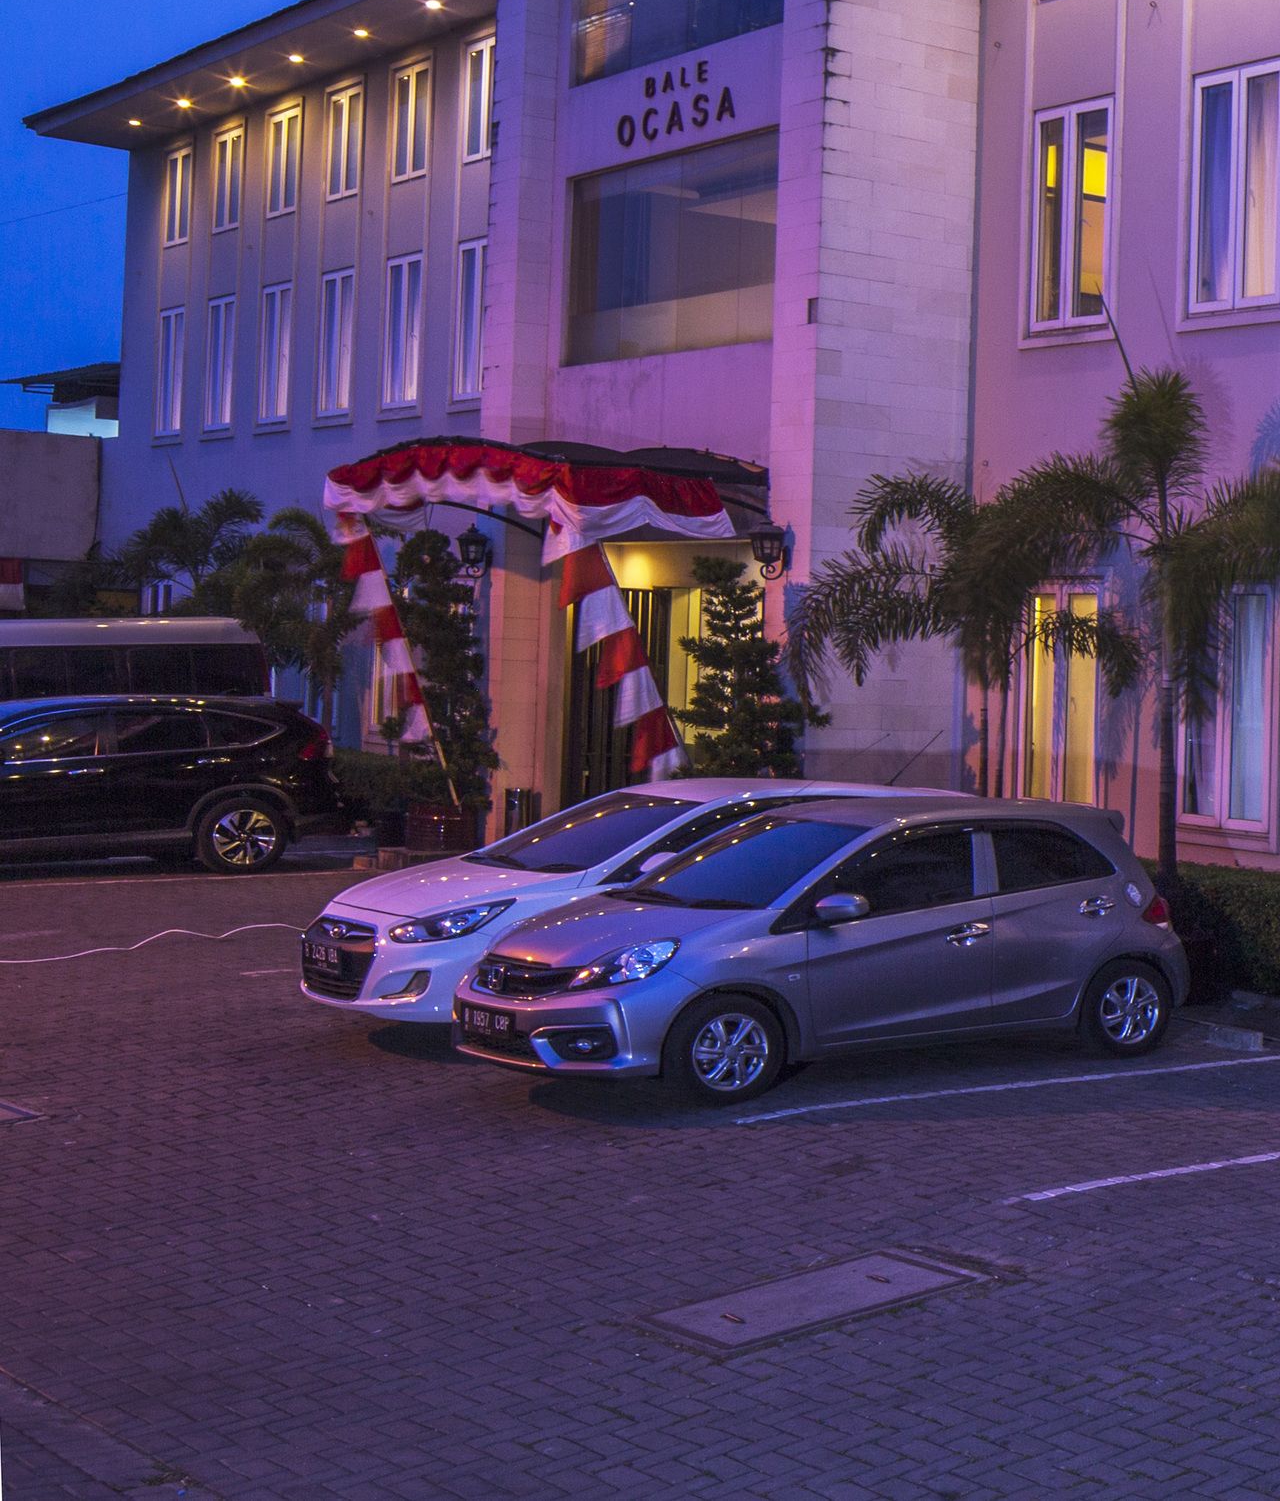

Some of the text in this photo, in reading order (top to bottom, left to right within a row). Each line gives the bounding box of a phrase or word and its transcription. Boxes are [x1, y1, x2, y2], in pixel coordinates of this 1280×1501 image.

[644, 60, 709, 98] BALE
[617, 86, 736, 147] OCASA
[473, 1010, 490, 1027] 1957
